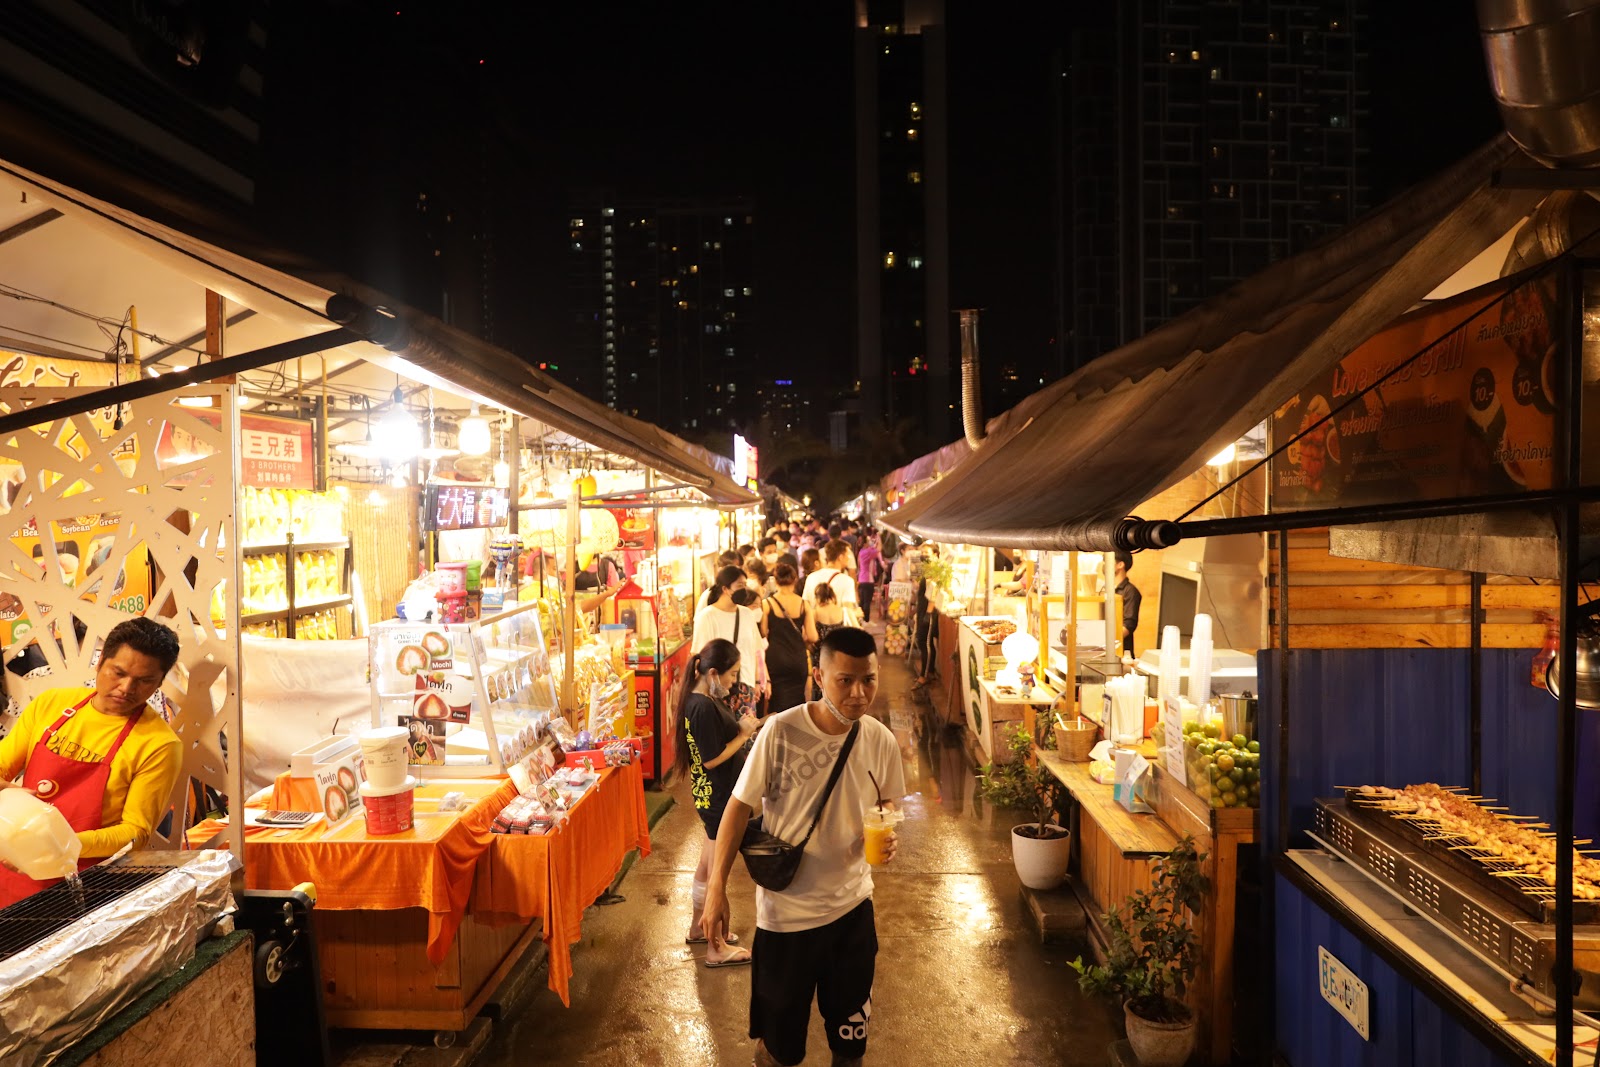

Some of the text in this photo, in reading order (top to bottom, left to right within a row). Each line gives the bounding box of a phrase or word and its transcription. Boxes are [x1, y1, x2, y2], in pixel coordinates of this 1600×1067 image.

[1331, 367, 1369, 399] Love
[250, 434, 296, 458] 三兄弟
[250, 460, 296, 471] 3 BROTHERS
[61, 523, 91, 535] Soybean
[432, 661, 452, 669] Mochi
